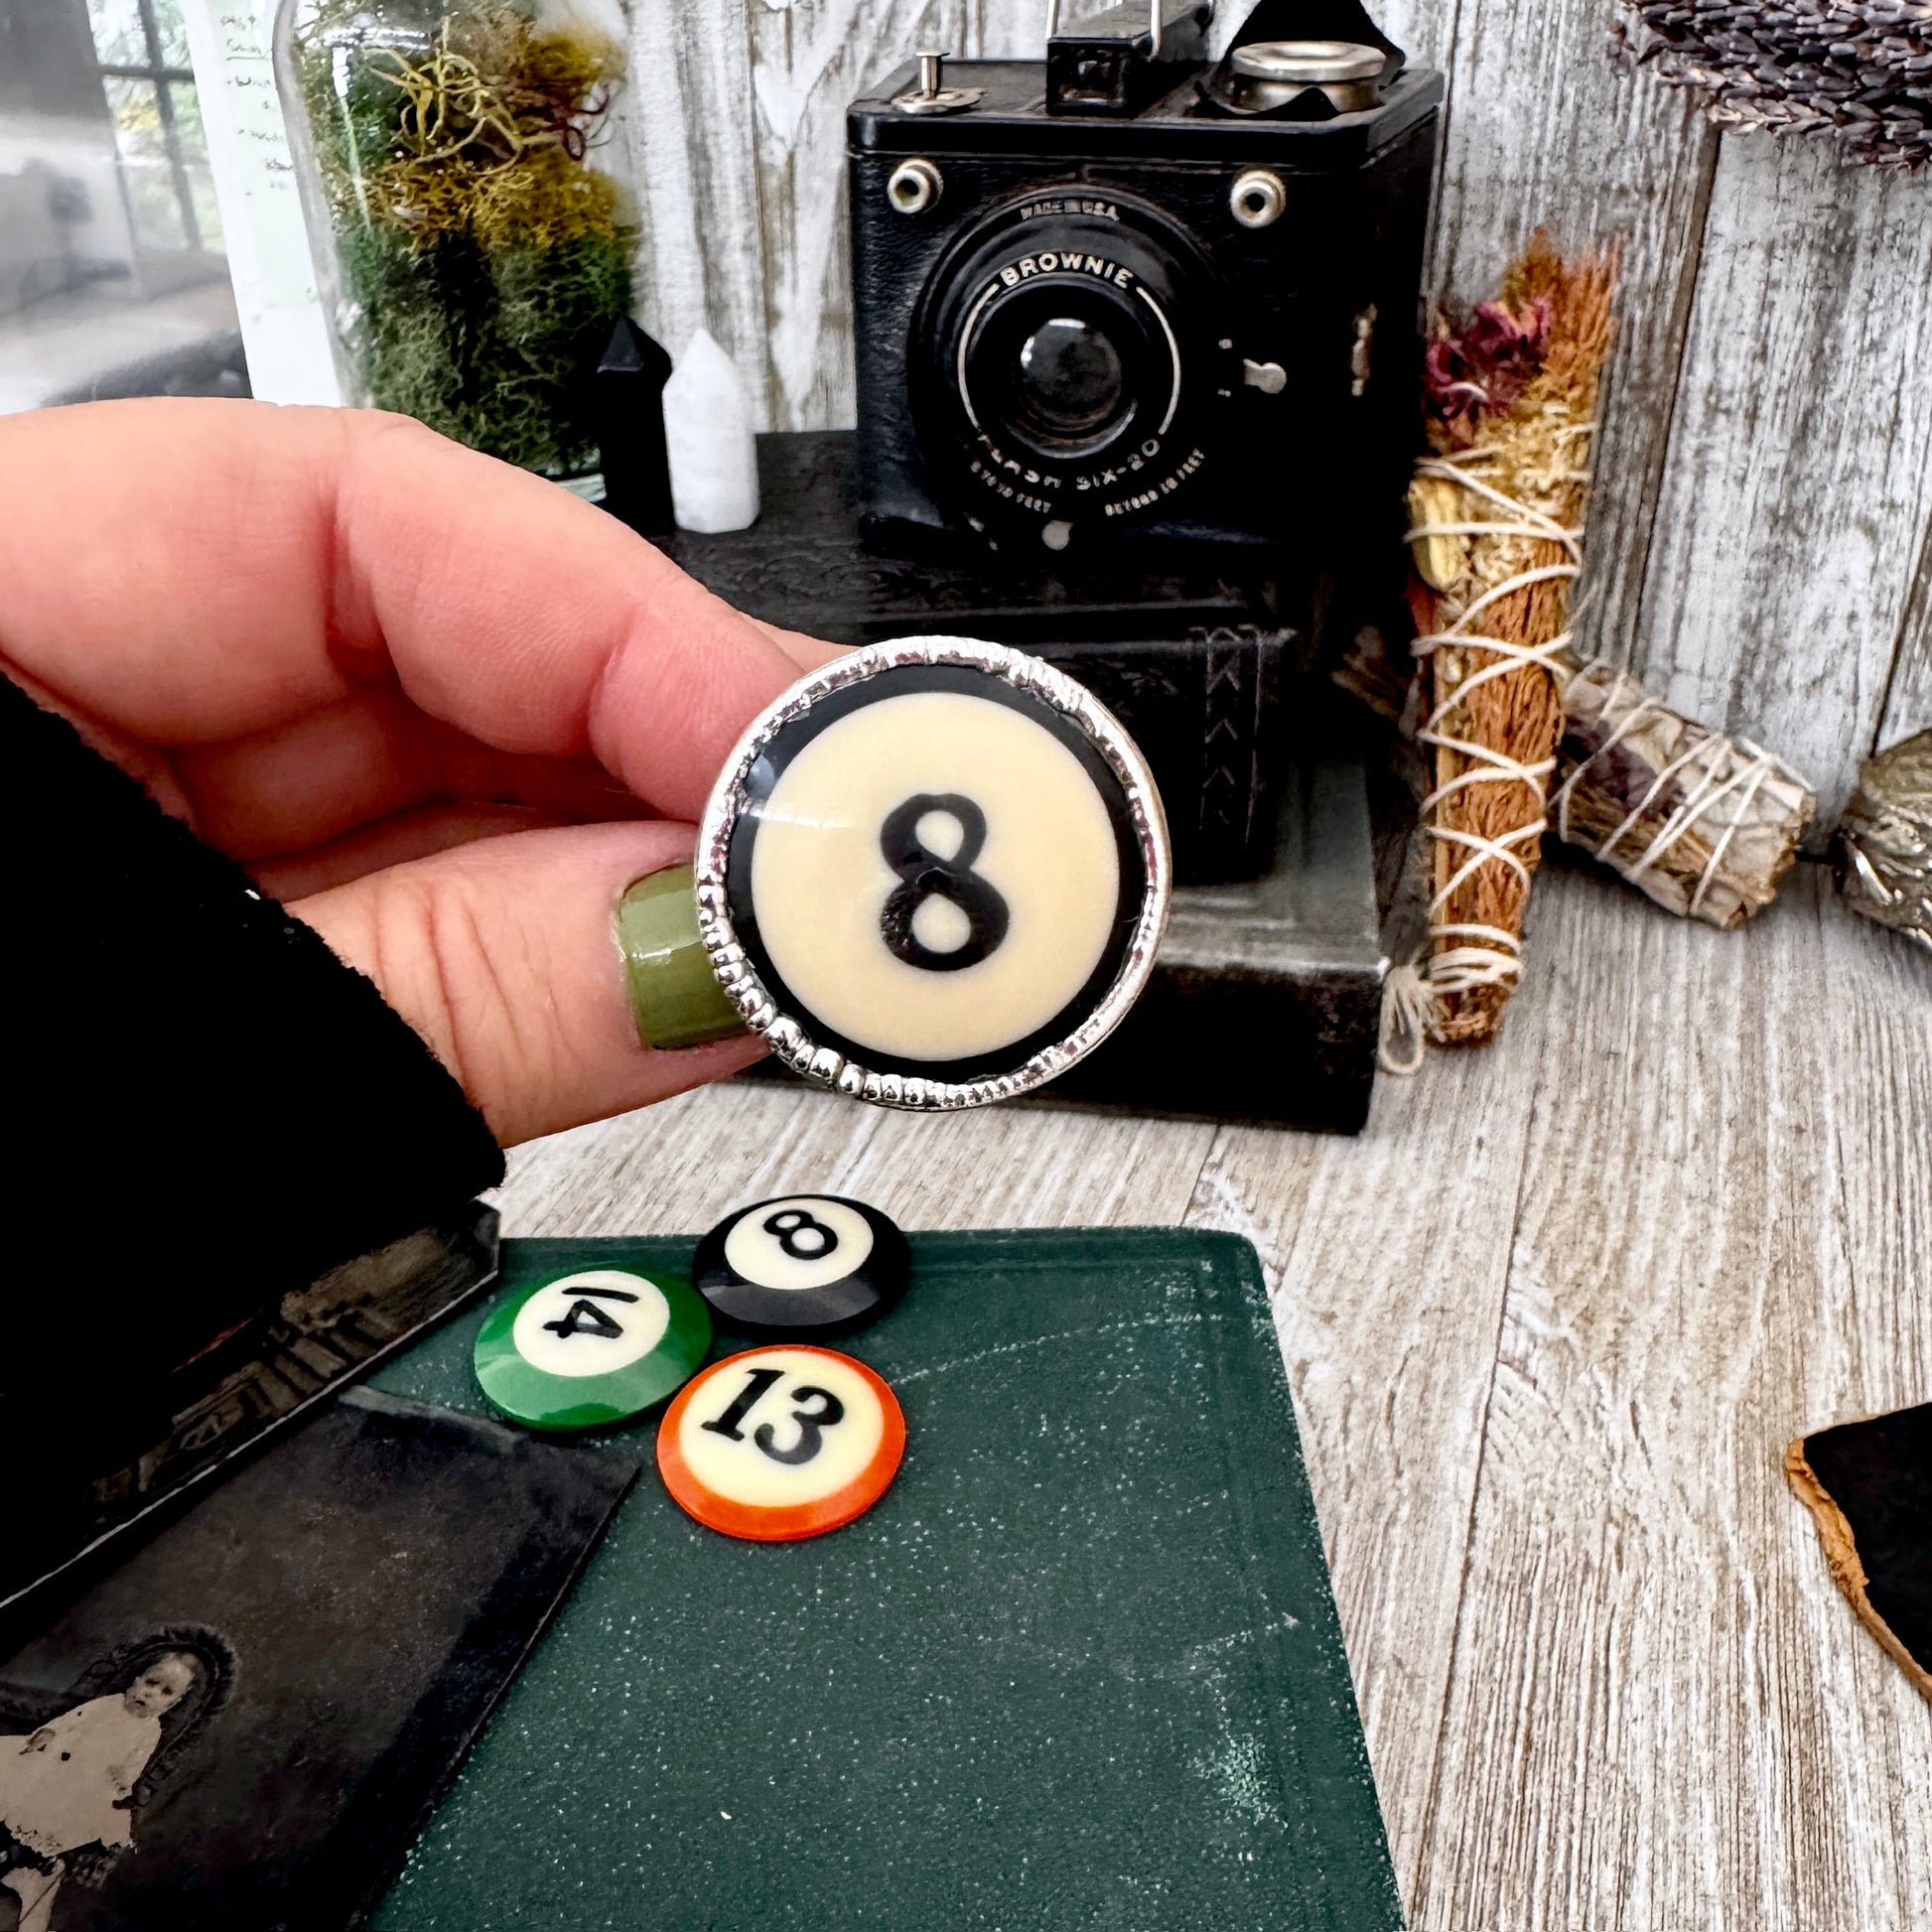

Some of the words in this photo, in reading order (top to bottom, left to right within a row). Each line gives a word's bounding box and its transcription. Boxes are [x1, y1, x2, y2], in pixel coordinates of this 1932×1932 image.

[1001, 252, 1134, 289] BROWNIE
[880, 792, 1010, 972] 8
[763, 1209, 838, 1261] 8
[542, 1287, 640, 1339] 14
[701, 1368, 846, 1465] 13
